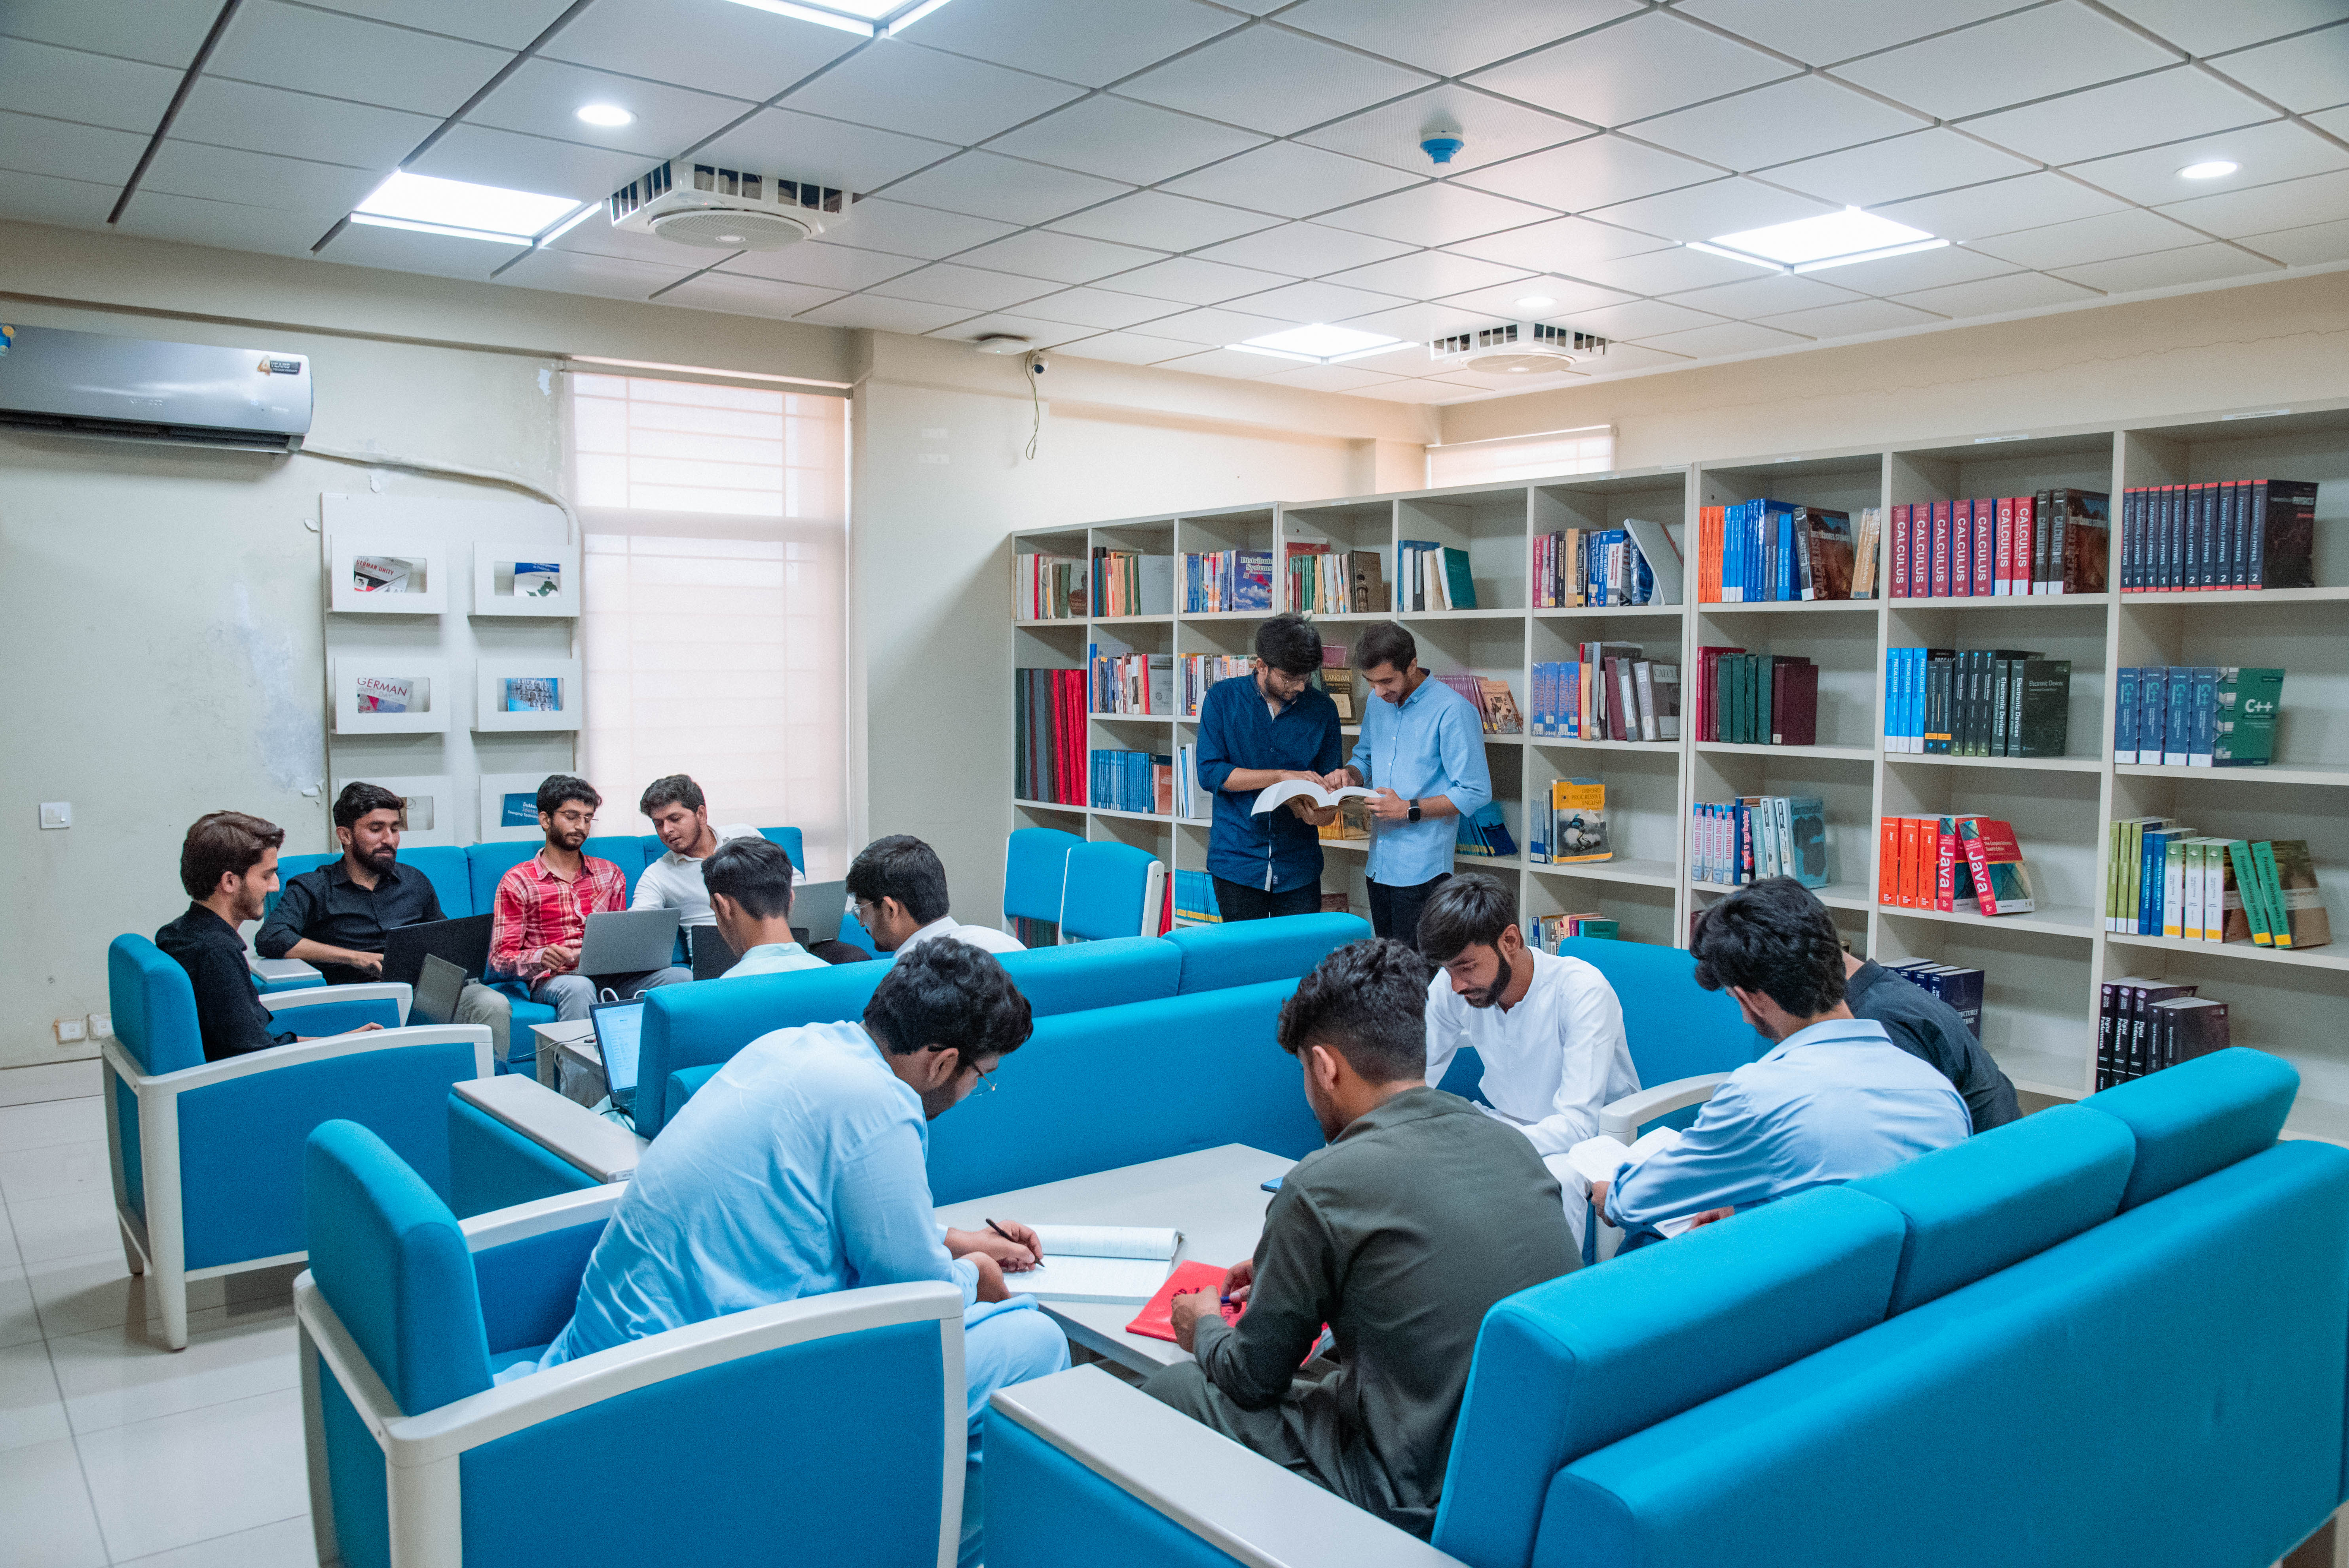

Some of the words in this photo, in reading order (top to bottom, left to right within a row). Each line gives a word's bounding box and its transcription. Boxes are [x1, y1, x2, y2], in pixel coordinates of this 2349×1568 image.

[1896, 522, 1905, 584] CALCULUS
[1916, 520, 1925, 582] CALCULUS
[1936, 520, 1945, 582] CALCULUS
[1956, 518, 1966, 581] CALCULUS
[1978, 517, 1987, 581] CALCULUS
[2000, 508, 2010, 567] CALCULUS
[2018, 508, 2028, 567] CALCULUS
[356, 559, 378, 570] GERMAN
[379, 566, 395, 576] UNITY
[1246, 563, 1272, 573] Systems
[1862, 536, 1872, 584] PROGRAMMING
[357, 678, 407, 697] GERMAN
[2125, 683, 2134, 704] C++
[2150, 682, 2159, 703] C++
[2176, 684, 2186, 705] C++
[2201, 684, 2211, 706] C++
[2245, 699, 2273, 713] C++
[1940, 847, 1954, 887] Java
[1969, 851, 1988, 893] Java
[2239, 855, 2248, 880] Problem
[2246, 881, 2254, 903] Solving
[2263, 856, 2272, 881] Problem
